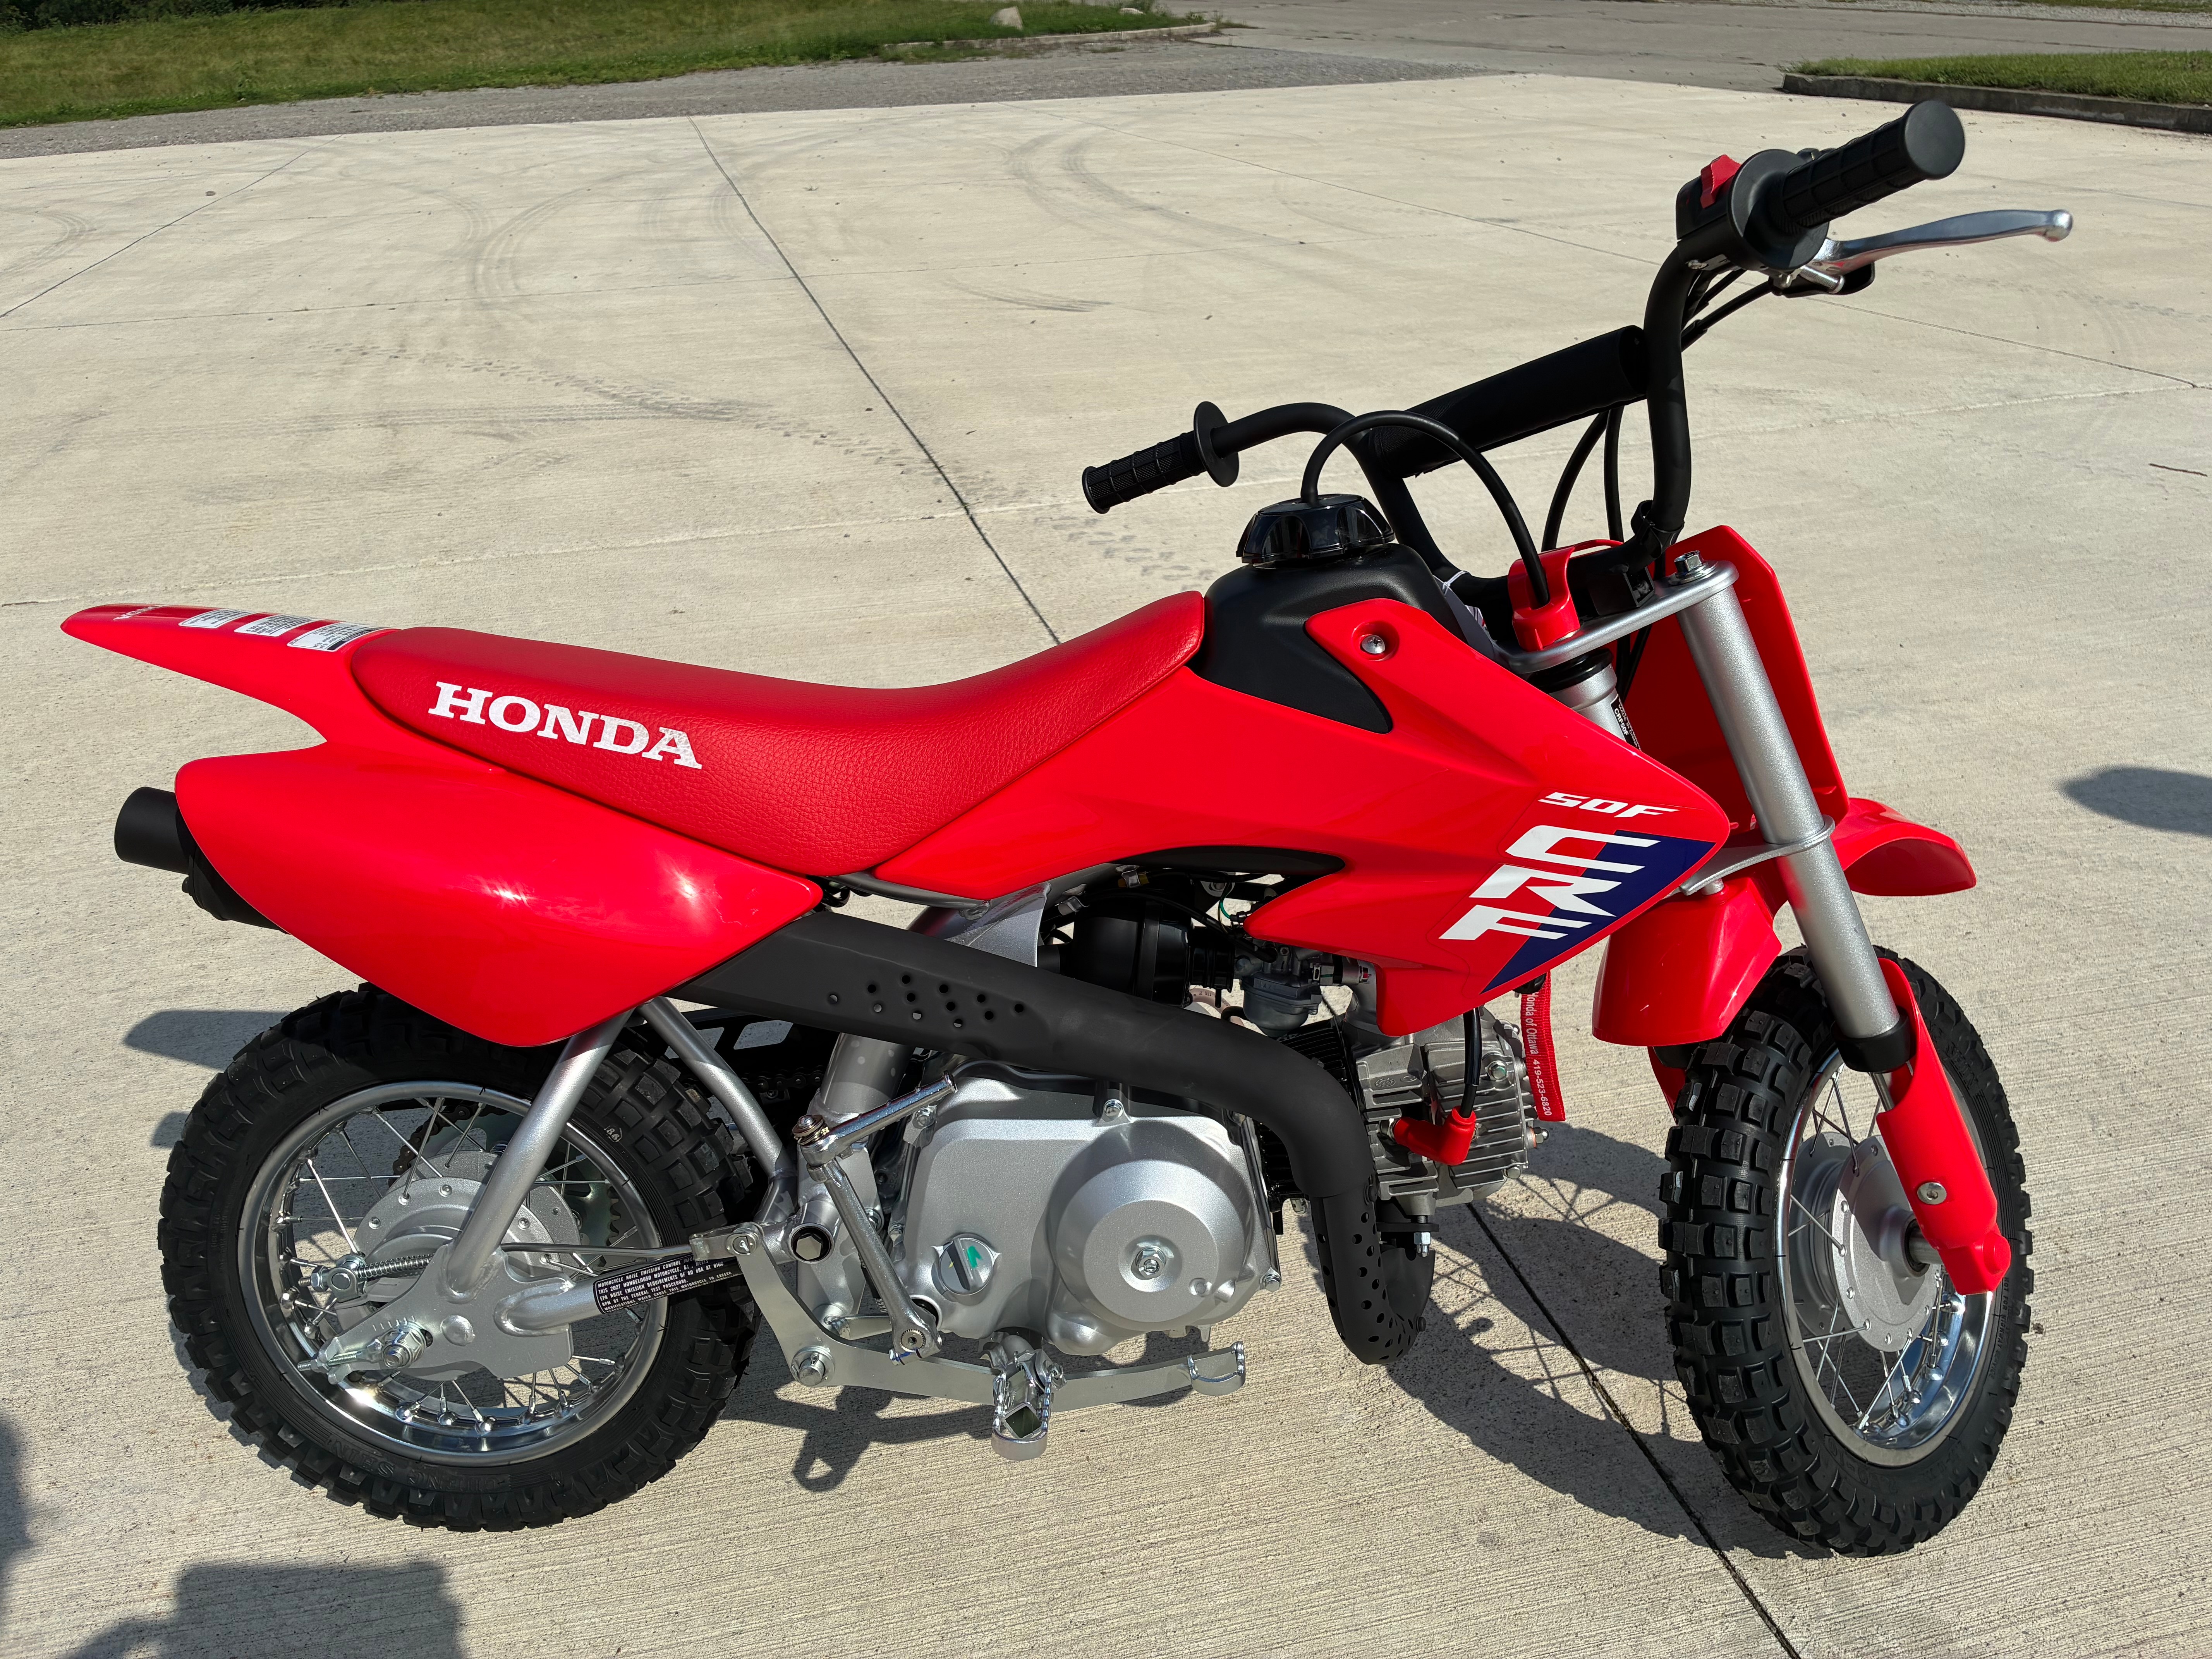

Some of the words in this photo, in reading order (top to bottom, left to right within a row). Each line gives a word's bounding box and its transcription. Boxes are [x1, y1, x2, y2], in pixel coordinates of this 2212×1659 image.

[428, 681, 702, 769] HONDA
[1614, 708, 1629, 735] CRF50F
[1618, 704, 1626, 721] MADE
[1538, 792, 1680, 817] 50F
[1439, 825, 1661, 940] CRF
[1525, 991, 1539, 1016] Honda
[1526, 1018, 1537, 1027] of
[1526, 1028, 1539, 1054] Ottawa
[1533, 1059, 1552, 1116] 419-523-6820
[598, 1277, 623, 1288] MOTORCYCLE
[641, 1266, 660, 1276] EMISSION
[663, 1260, 681, 1269] CONTROL
[625, 1284, 645, 1294] EMISSION
[647, 1274, 678, 1288] REQUIREMENTS
[654, 1267, 681, 1279] MOTORCYCLE,
[604, 1299, 636, 1311] MODIFICATIONS
[680, 1278, 707, 1288] MOTORCYCLE
[631, 1290, 649, 1298] FEDERAL
[663, 1279, 689, 1289] PROCEDURE.
